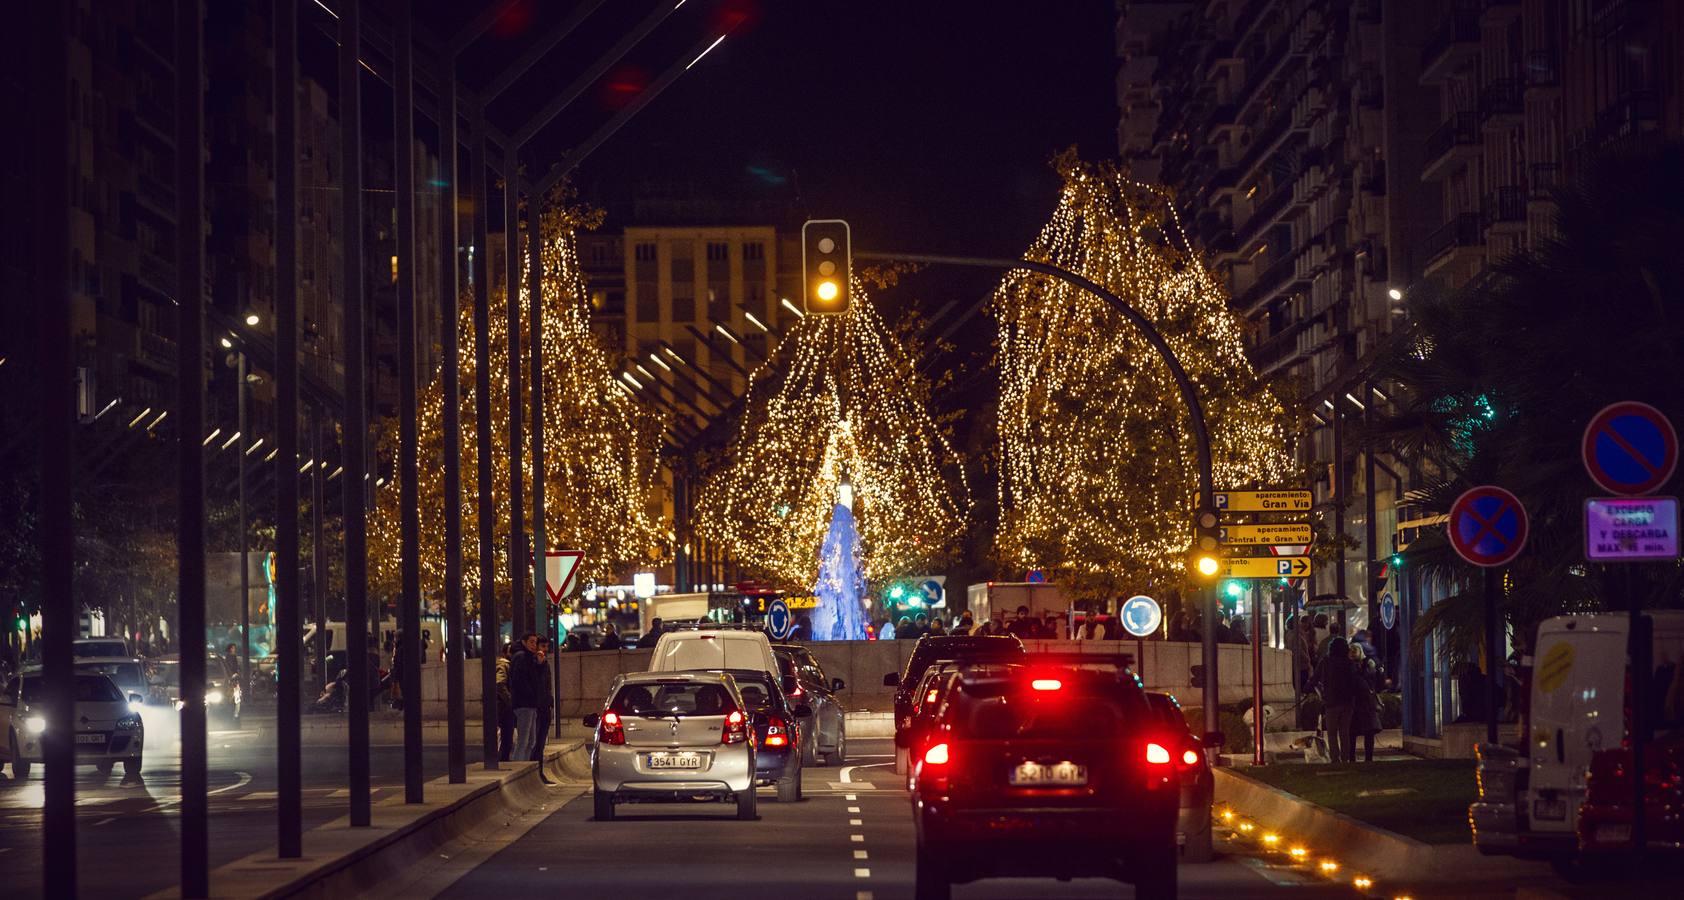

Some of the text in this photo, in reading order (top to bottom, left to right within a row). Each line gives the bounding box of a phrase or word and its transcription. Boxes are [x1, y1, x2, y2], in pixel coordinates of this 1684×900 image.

[1215, 495, 1226, 508] P
[1262, 500, 1287, 508] Gran
[1599, 528, 1669, 539] Y DESCARGA
[1279, 561, 1290, 574] P
[758, 598, 765, 611] 3
[654, 757, 697, 766] 3541 GYR
